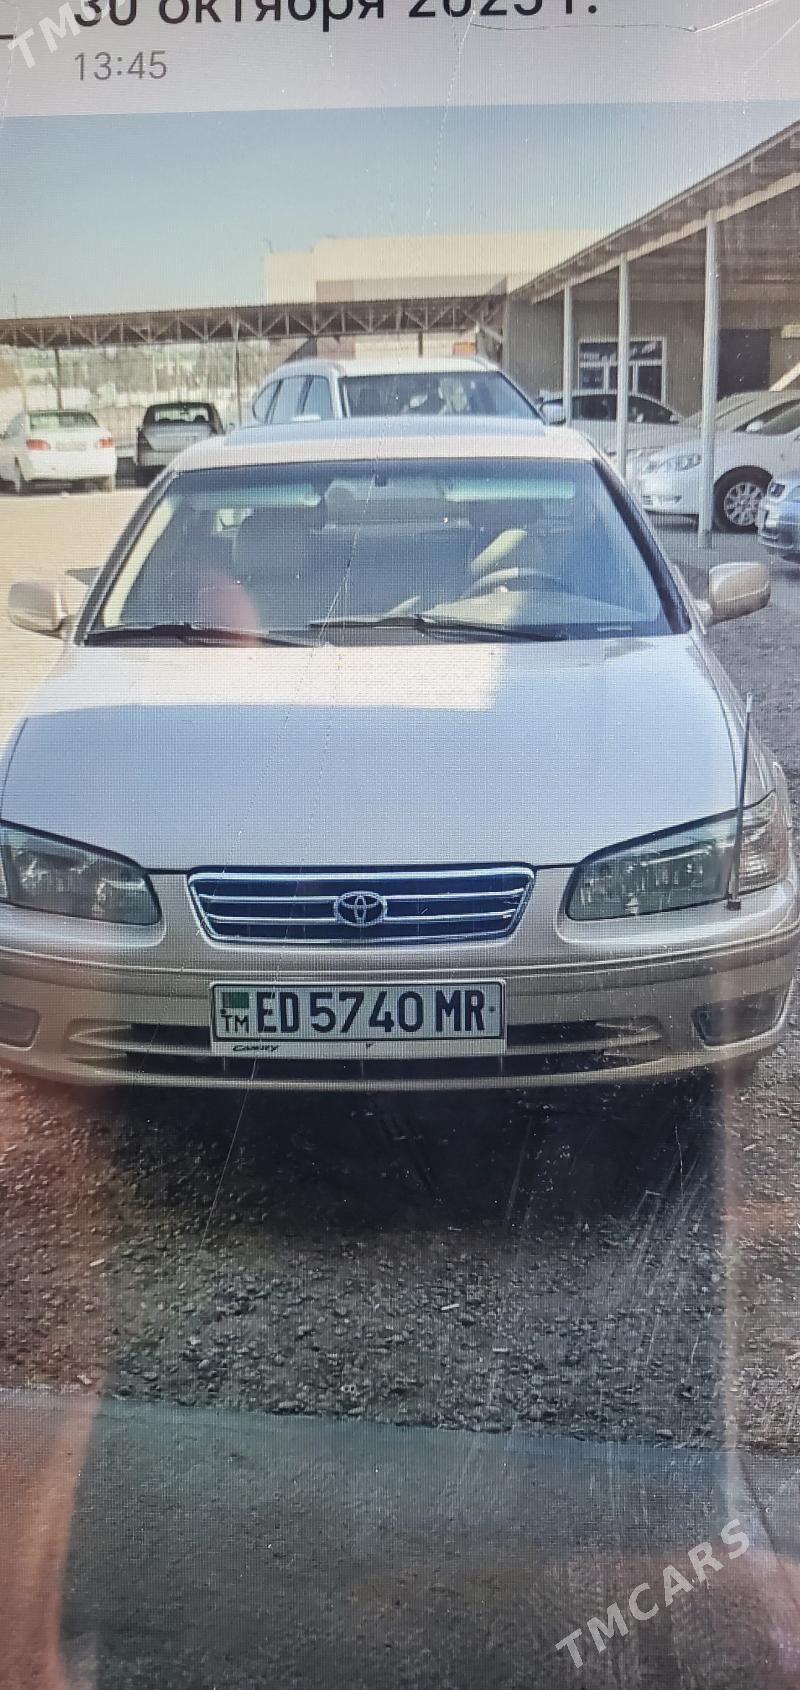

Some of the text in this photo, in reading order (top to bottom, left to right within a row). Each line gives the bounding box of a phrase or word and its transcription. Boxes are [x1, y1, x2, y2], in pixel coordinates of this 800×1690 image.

[74, 51, 167, 80] 13:45
[221, 989, 485, 1033] TM ED 5740 MR
